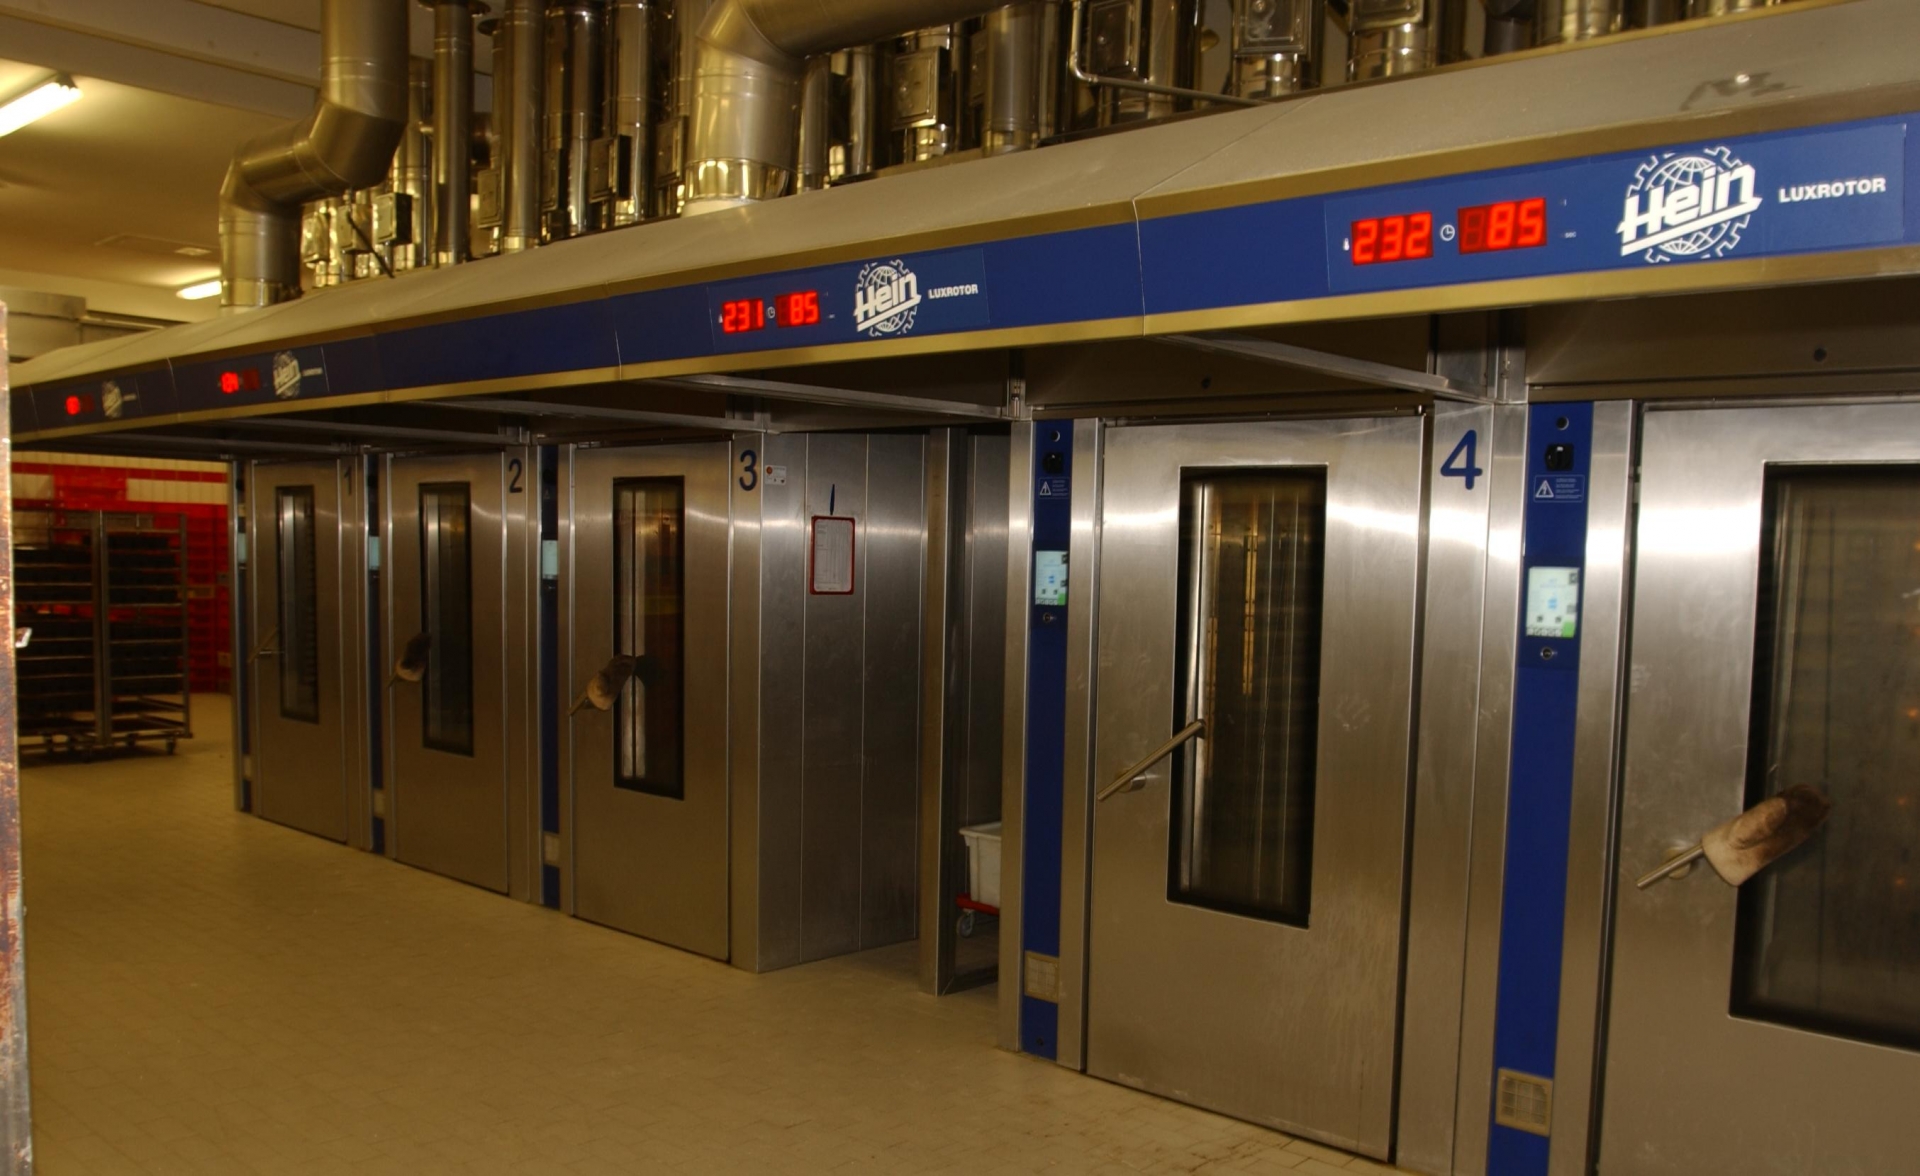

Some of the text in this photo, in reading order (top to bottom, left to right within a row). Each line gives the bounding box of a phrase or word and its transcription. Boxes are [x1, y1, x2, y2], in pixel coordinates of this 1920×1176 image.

[1488, 198, 1545, 247] 85
[1617, 164, 1886, 244] Hein LUXROTOR
[1352, 213, 1432, 263] 232
[723, 300, 764, 333] 231
[790, 292, 819, 324] 85
[854, 271, 979, 325] Hein LUXROTOR
[344, 465, 352, 496] 1
[508, 458, 523, 493] 2
[739, 449, 757, 490] 3
[1440, 429, 1483, 490] 4
